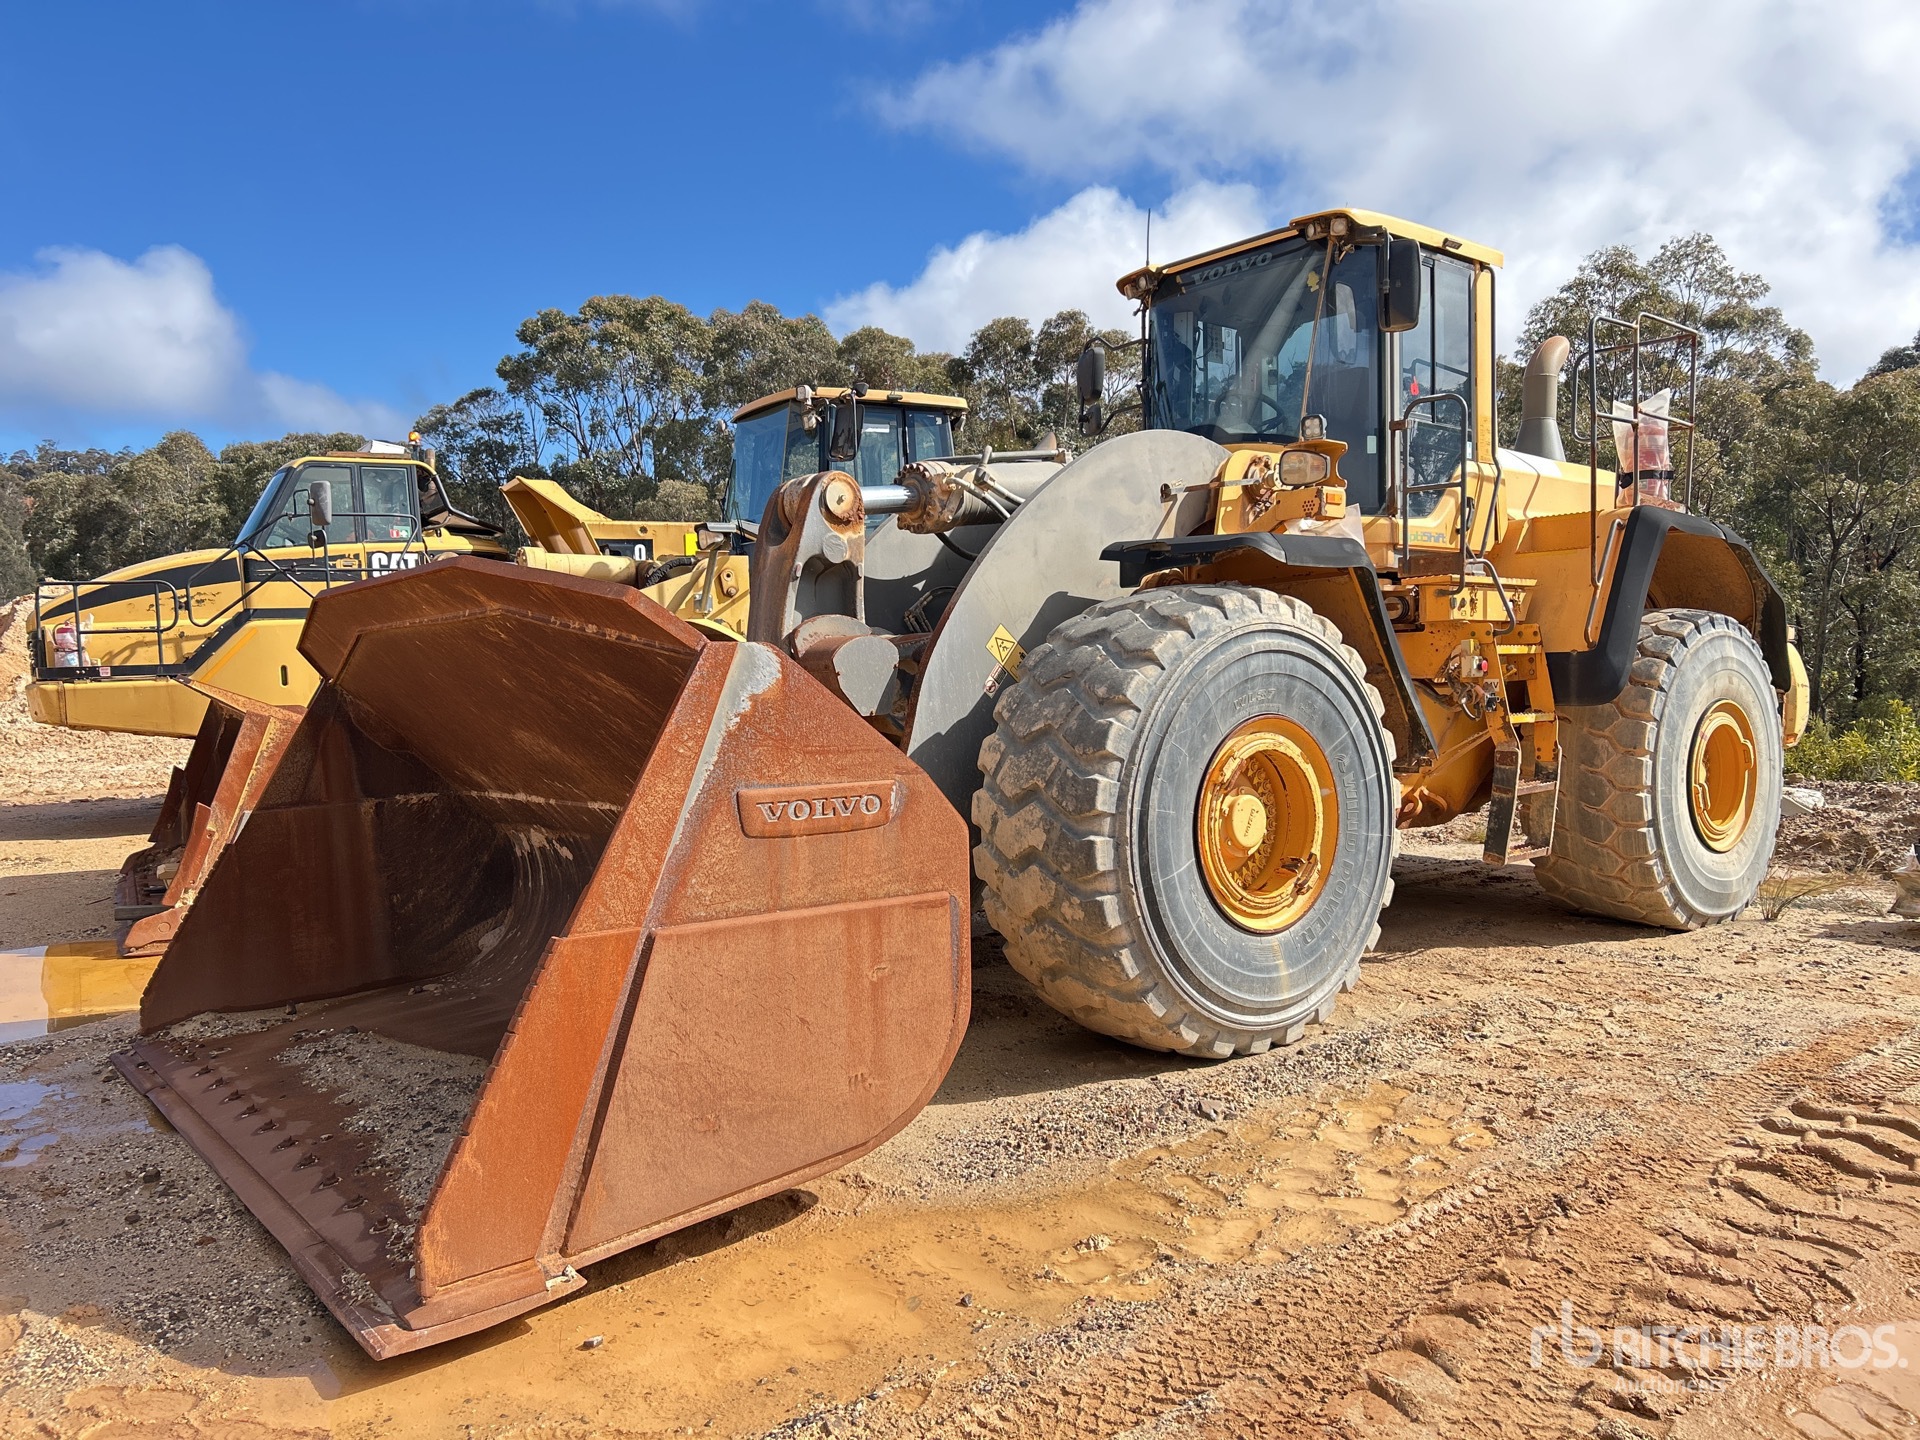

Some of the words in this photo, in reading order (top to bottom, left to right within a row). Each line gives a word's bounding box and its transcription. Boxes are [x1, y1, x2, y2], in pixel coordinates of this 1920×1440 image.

[1191, 252, 1273, 286] VOLVO
[1401, 531, 1447, 544] ptiShift
[371, 552, 419, 578] CAT
[755, 794, 882, 823] VOLVO
[1300, 858, 1355, 947] POWER
